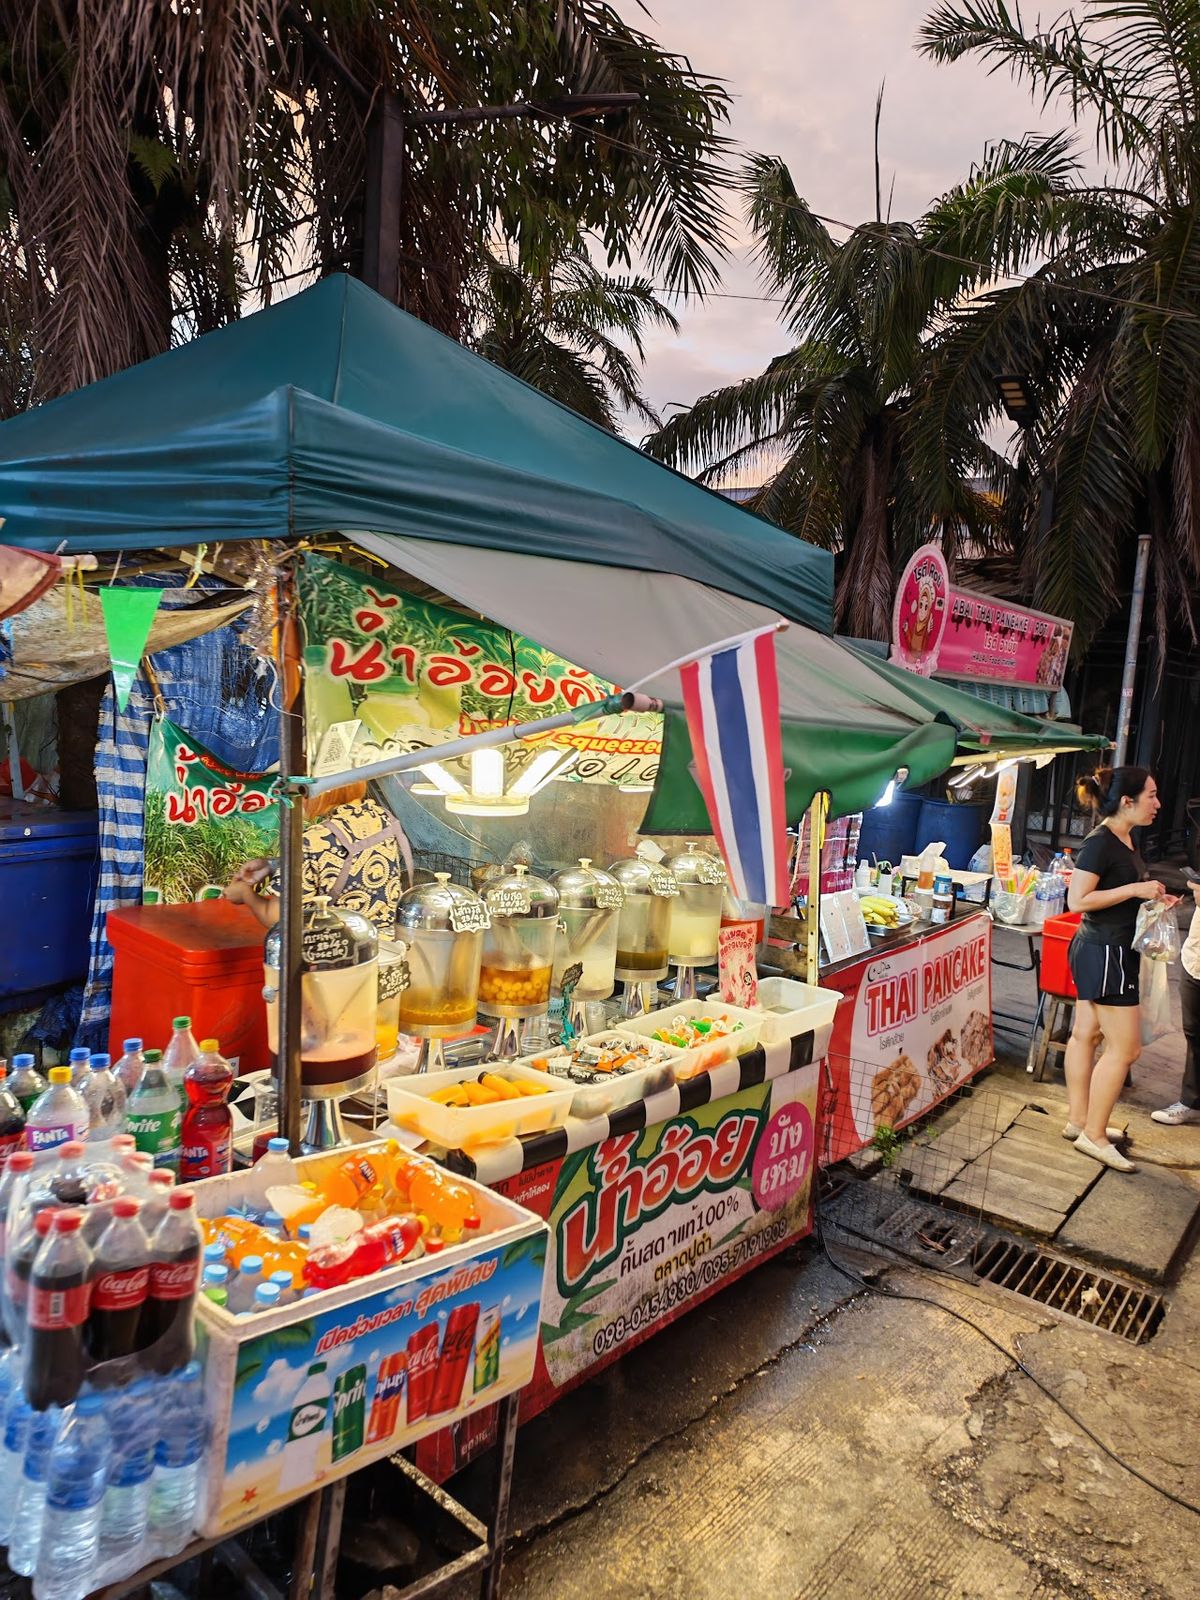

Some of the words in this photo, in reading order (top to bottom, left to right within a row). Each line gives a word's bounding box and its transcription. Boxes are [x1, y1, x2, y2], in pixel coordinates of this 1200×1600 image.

[976, 604, 994, 624] THAI
[866, 969, 918, 1035] THAI
[923, 935, 986, 1013] PANCAKE
[32, 1128, 70, 1145] FANTA
